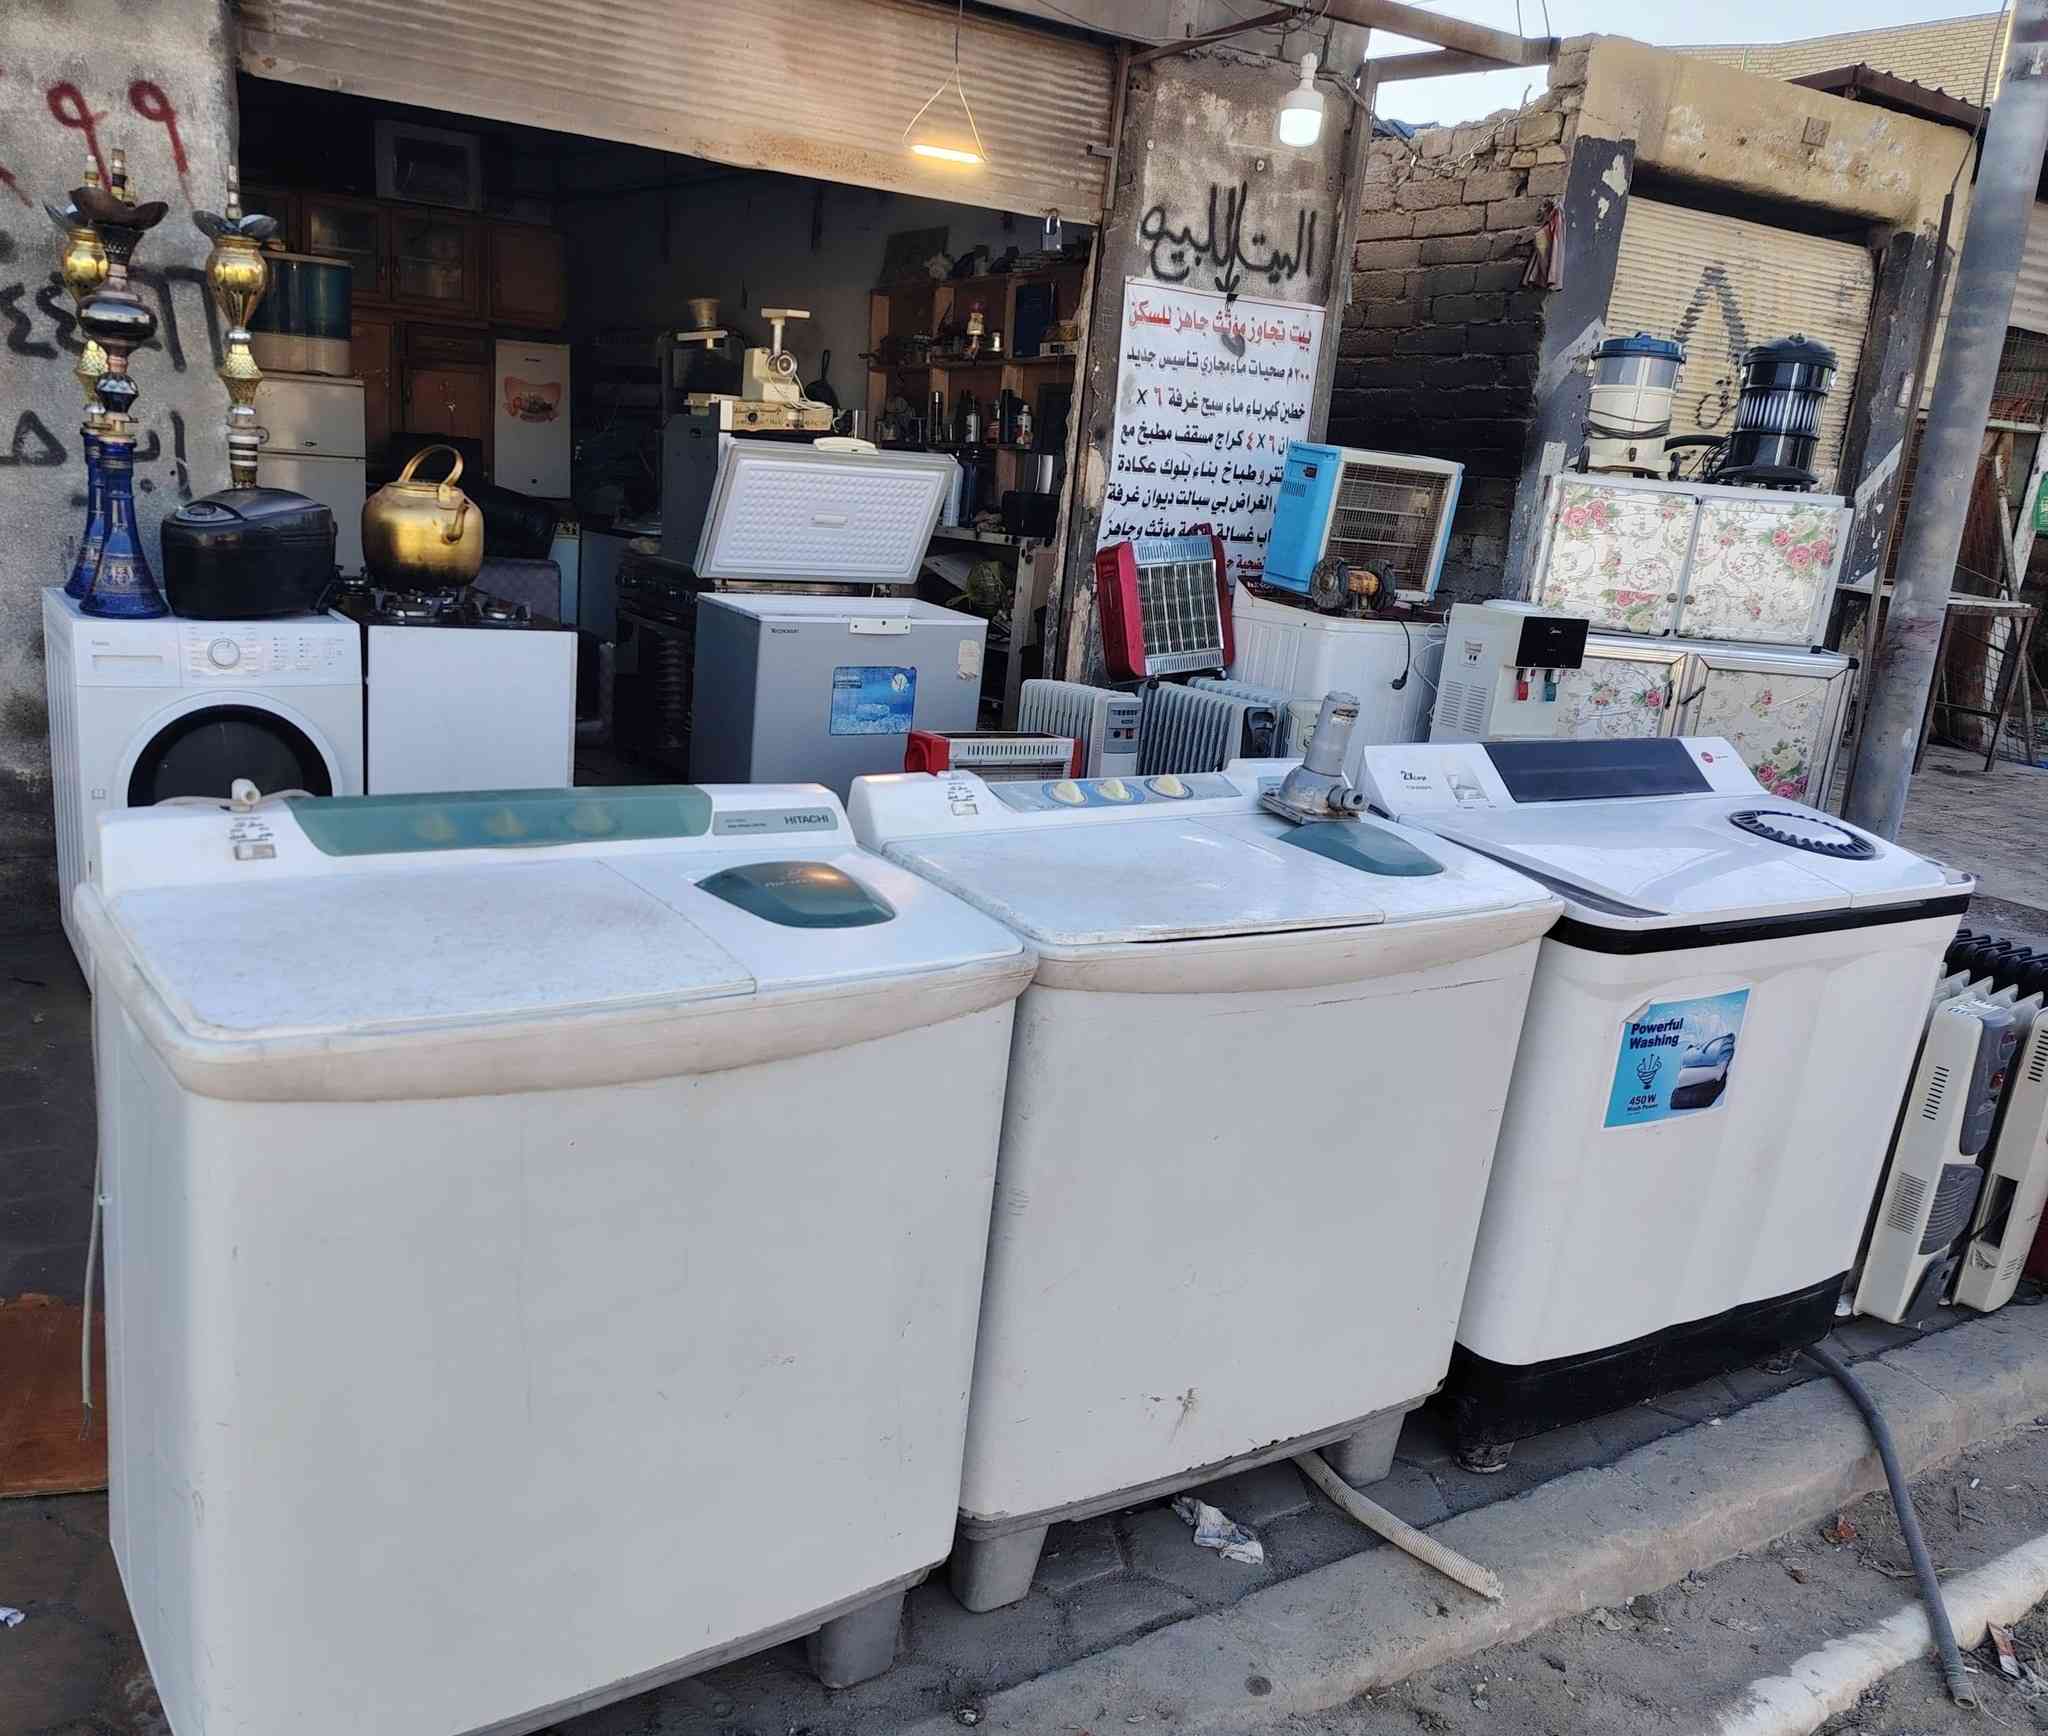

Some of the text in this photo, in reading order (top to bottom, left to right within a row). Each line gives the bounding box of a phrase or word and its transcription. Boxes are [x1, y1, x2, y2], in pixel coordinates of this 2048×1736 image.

[1141, 181, 1317, 284] البيت للبيع
[1174, 307, 1209, 336] جاهز
[1248, 316, 1285, 346] تجاوز
[1127, 348, 1156, 369] جديد
[1200, 356, 1230, 377] مجاري
[1248, 359, 1286, 382] صحيات
[1168, 386, 1199, 413] غرفة
[1225, 396, 1244, 413] ماء
[1246, 399, 1280, 423] كهرباء
[1120, 423, 1136, 444] مع
[1137, 421, 1172, 445] مطبخ
[1174, 424, 1214, 444] مسقف
[1214, 429, 1245, 450] كراج
[1117, 454, 1157, 474] عكادة
[1159, 456, 1192, 482] بلوك
[1192, 462, 1218, 484] بناء
[1107, 483, 1140, 506] غرفة
[1142, 488, 1174, 511] ديوان
[1211, 495, 1228, 515] بي
[1217, 523, 1254, 543] غسالة
[784, 815, 829, 825] HITACHI
[1631, 1018, 1684, 1036] Powerful
[1629, 1033, 1680, 1050] Washing
